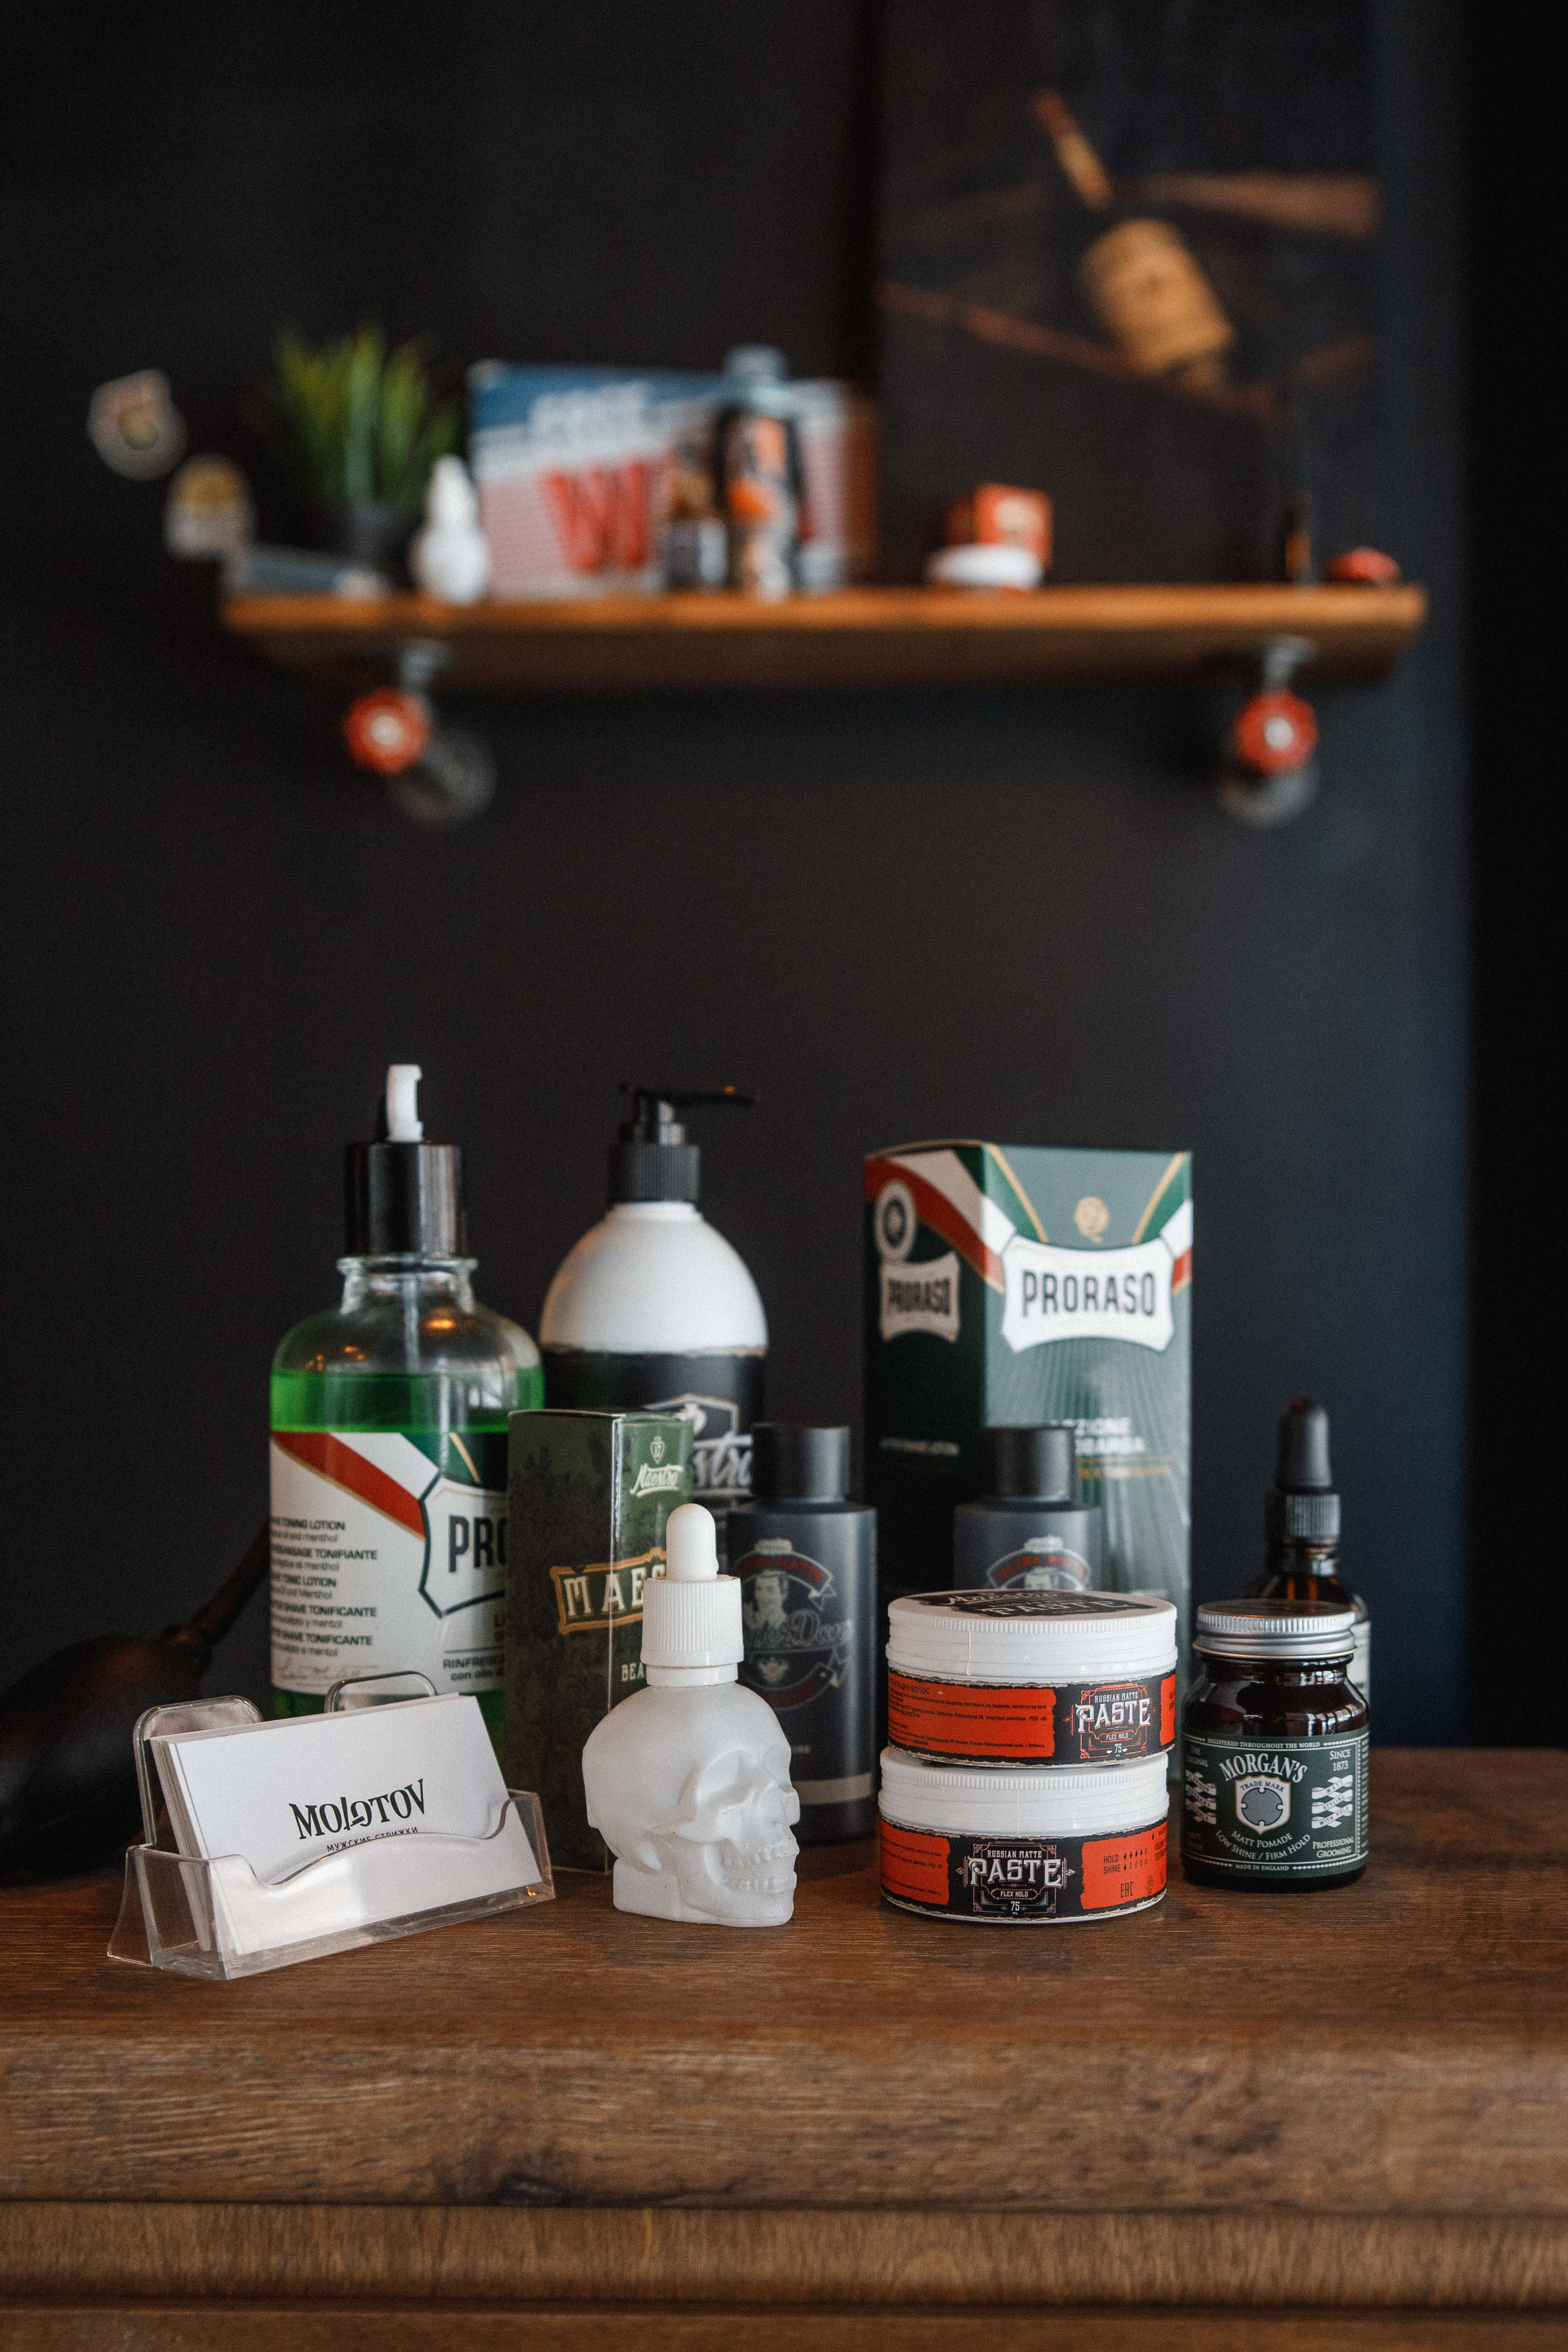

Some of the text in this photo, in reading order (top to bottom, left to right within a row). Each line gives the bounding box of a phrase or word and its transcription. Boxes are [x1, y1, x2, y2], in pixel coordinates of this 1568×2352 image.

[1023, 1270, 1156, 1318] PRORASO
[309, 1520, 345, 1531] LOTION
[315, 1548, 378, 1560] TONIFIANTE
[303, 1577, 336, 1587] LOTION
[309, 1605, 377, 1617] TONIFICANTE
[306, 1633, 372, 1646] TONIFICANTE
[1121, 1691, 1138, 1701] MATTE
[1075, 1698, 1150, 1733] PASTE
[1114, 1743, 1121, 1753] 75
[1207, 1738, 1238, 1747] REGISTERED
[1329, 1749, 1351, 1760] SINCE
[1219, 1753, 1308, 1783] MORGAN'S
[1332, 1760, 1349, 1771] 1873
[1240, 1781, 1285, 1792] TRADE MARK
[1326, 1781, 1343, 1793] MATT
[1319, 1815, 1334, 1825] WITH
[1231, 1830, 1293, 1848] MATT POMADE
[1313, 1836, 1354, 1849] PROFESSIONAL
[1215, 1830, 1232, 1848] LOW
[1231, 1844, 1256, 1860] SHINE
[1265, 1849, 1287, 1860] FIRM
[1287, 1834, 1311, 1854] HOLD
[987, 1850, 1014, 1858] RUSSIAN
[1316, 1845, 1352, 1858] GROOMING
[1103, 1854, 1119, 1864] HOLD
[967, 1856, 1063, 1888] PASTE
[1103, 1864, 1120, 1874] SHINE
[1011, 1901, 1020, 1911] 75
